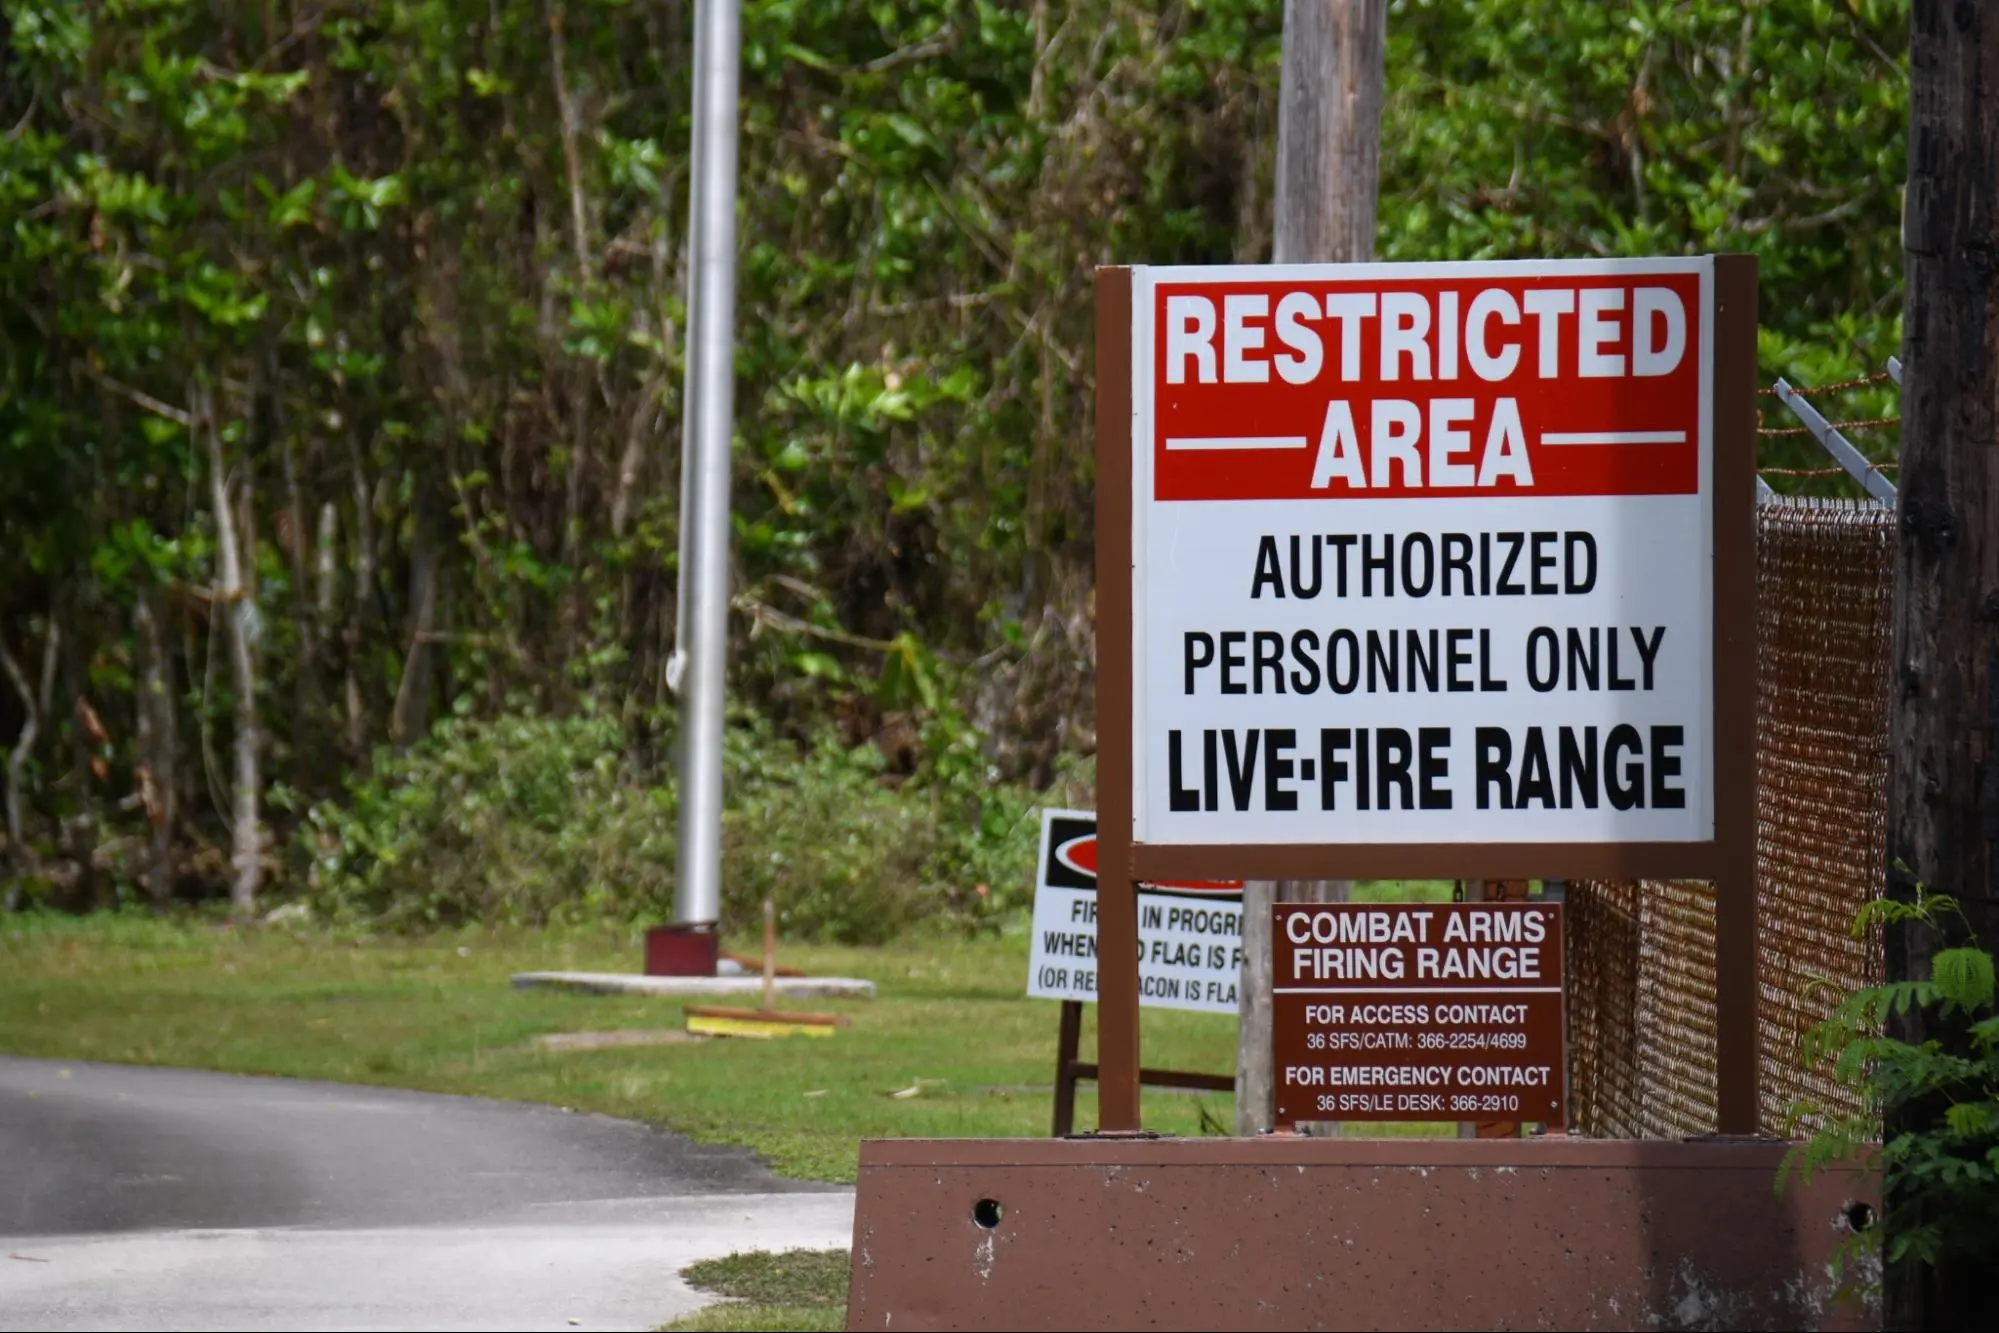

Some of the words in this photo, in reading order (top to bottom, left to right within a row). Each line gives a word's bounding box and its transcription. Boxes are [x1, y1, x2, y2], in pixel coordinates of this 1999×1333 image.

[1166, 288, 1687, 386] RESTRICTED
[1310, 398, 1534, 490] AREA
[1250, 531, 1598, 599] AUTHORIZED
[1184, 628, 1508, 695] PERSONNEL
[1526, 626, 1666, 694] ONLY
[1475, 724, 1686, 810] RANGE
[1070, 899, 1098, 923] FIR
[1142, 906, 1162, 928] IN
[1168, 908, 1243, 936] PROGR
[1286, 911, 1434, 944] COMBAT
[1443, 911, 1546, 943] ARMS
[1151, 941, 1201, 967] FLAG
[1207, 945, 1225, 970] IS
[1293, 948, 1404, 979] FIRING
[1417, 947, 1541, 979] RANGE
[1038, 965, 1067, 989] (OR
[1073, 970, 1098, 992] RE
[1185, 980, 1201, 1001] IS
[1305, 1005, 1344, 1024] FOR
[1350, 1005, 1429, 1024] ACCESS
[1434, 1005, 1528, 1024] CONTACT
[1306, 1033, 1325, 1049] 36
[1329, 1032, 1413, 1050] SFS/CATM:
[1417, 1032, 1526, 1050] 366-2254/4699
[1285, 1067, 1324, 1085] FOR
[1330, 1067, 1452, 1086] EMERGENCY
[1456, 1067, 1550, 1086] CONTACT
[1316, 1095, 1335, 1111] 36
[1339, 1094, 1393, 1112] SFS/LE
[1398, 1095, 1446, 1111] DESK:
[1450, 1094, 1518, 1112] 366-2910
